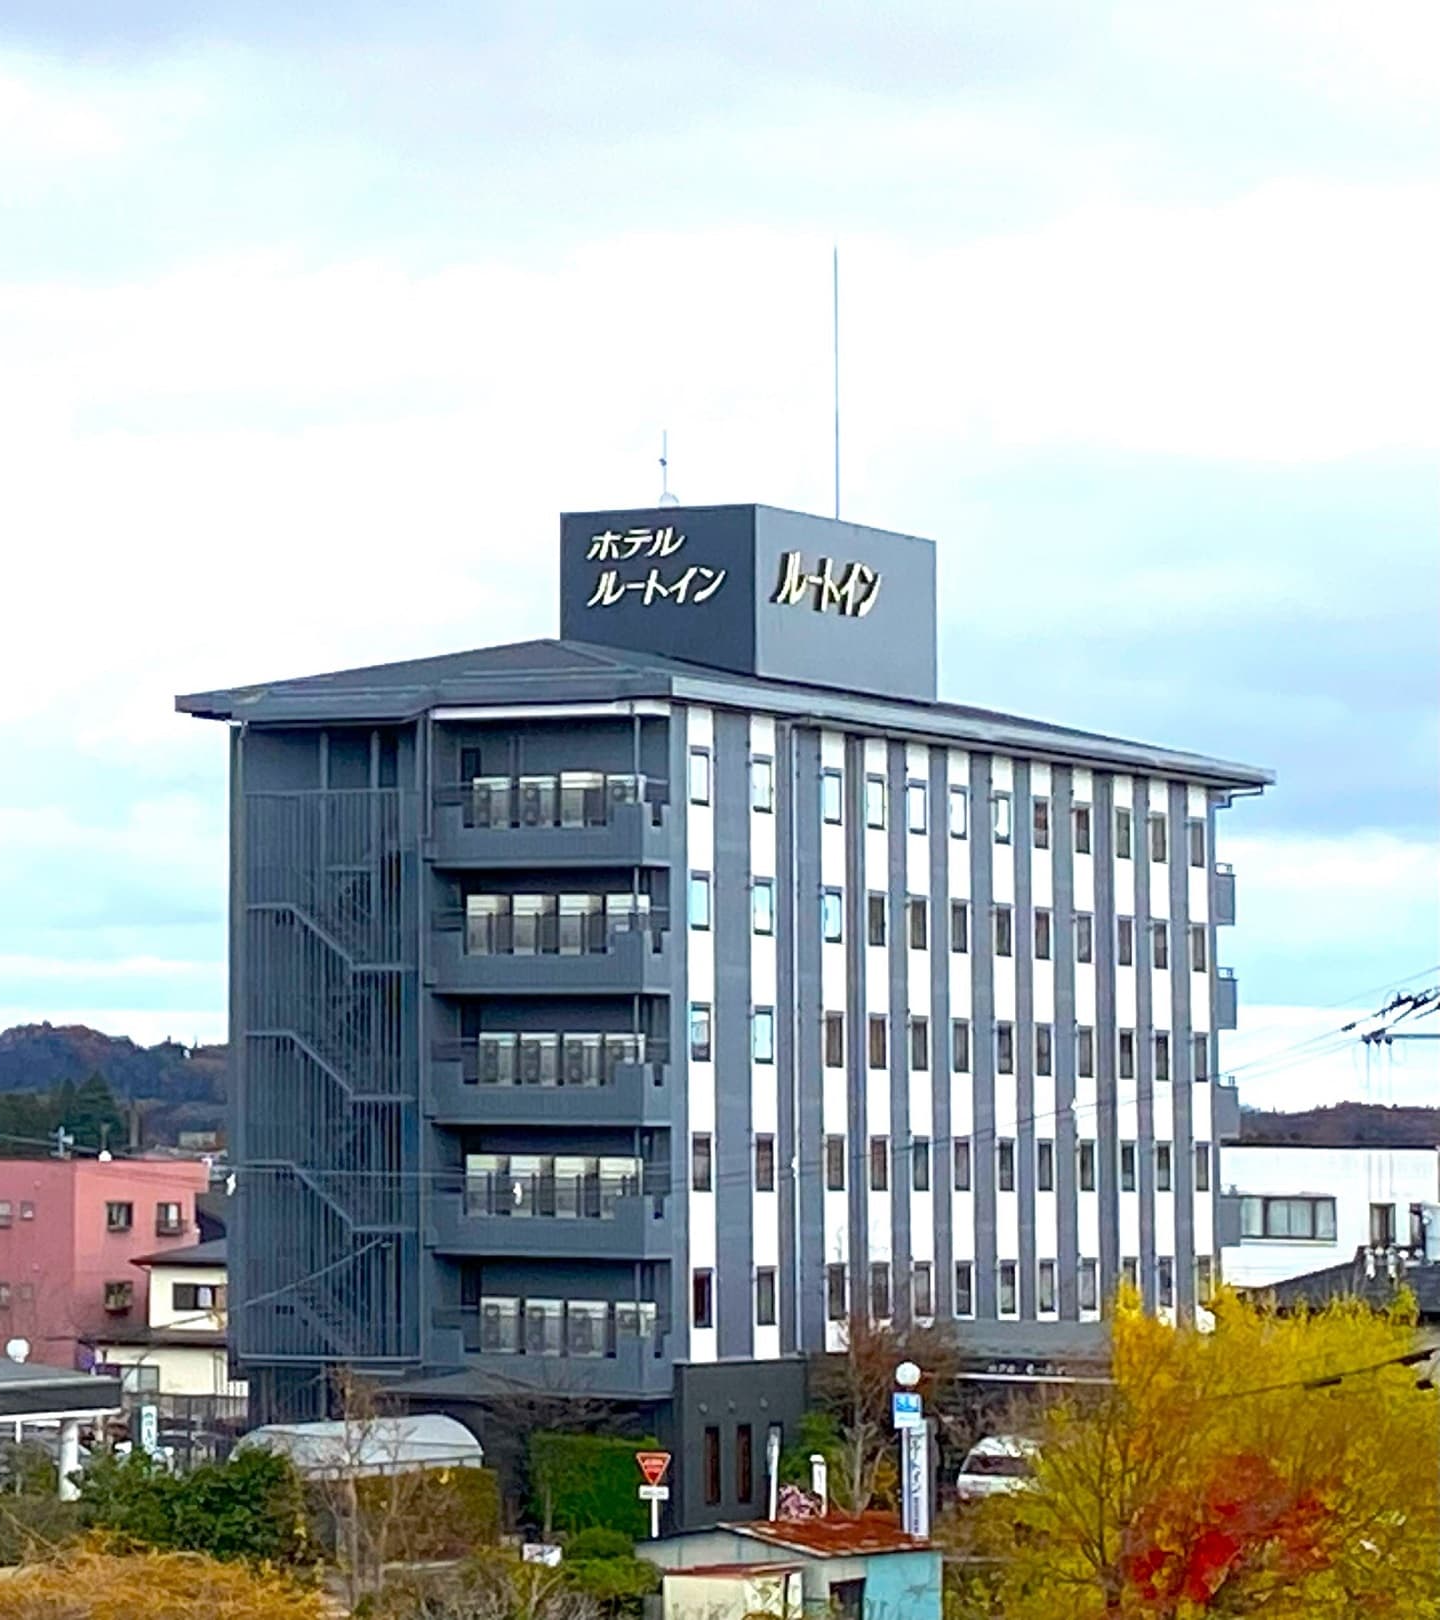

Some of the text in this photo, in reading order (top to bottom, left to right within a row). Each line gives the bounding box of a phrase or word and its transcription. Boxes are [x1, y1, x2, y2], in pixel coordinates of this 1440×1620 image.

[586, 527, 685, 560] ホテル
[586, 567, 726, 607] ルートイン
[777, 551, 882, 617] ルートイン
